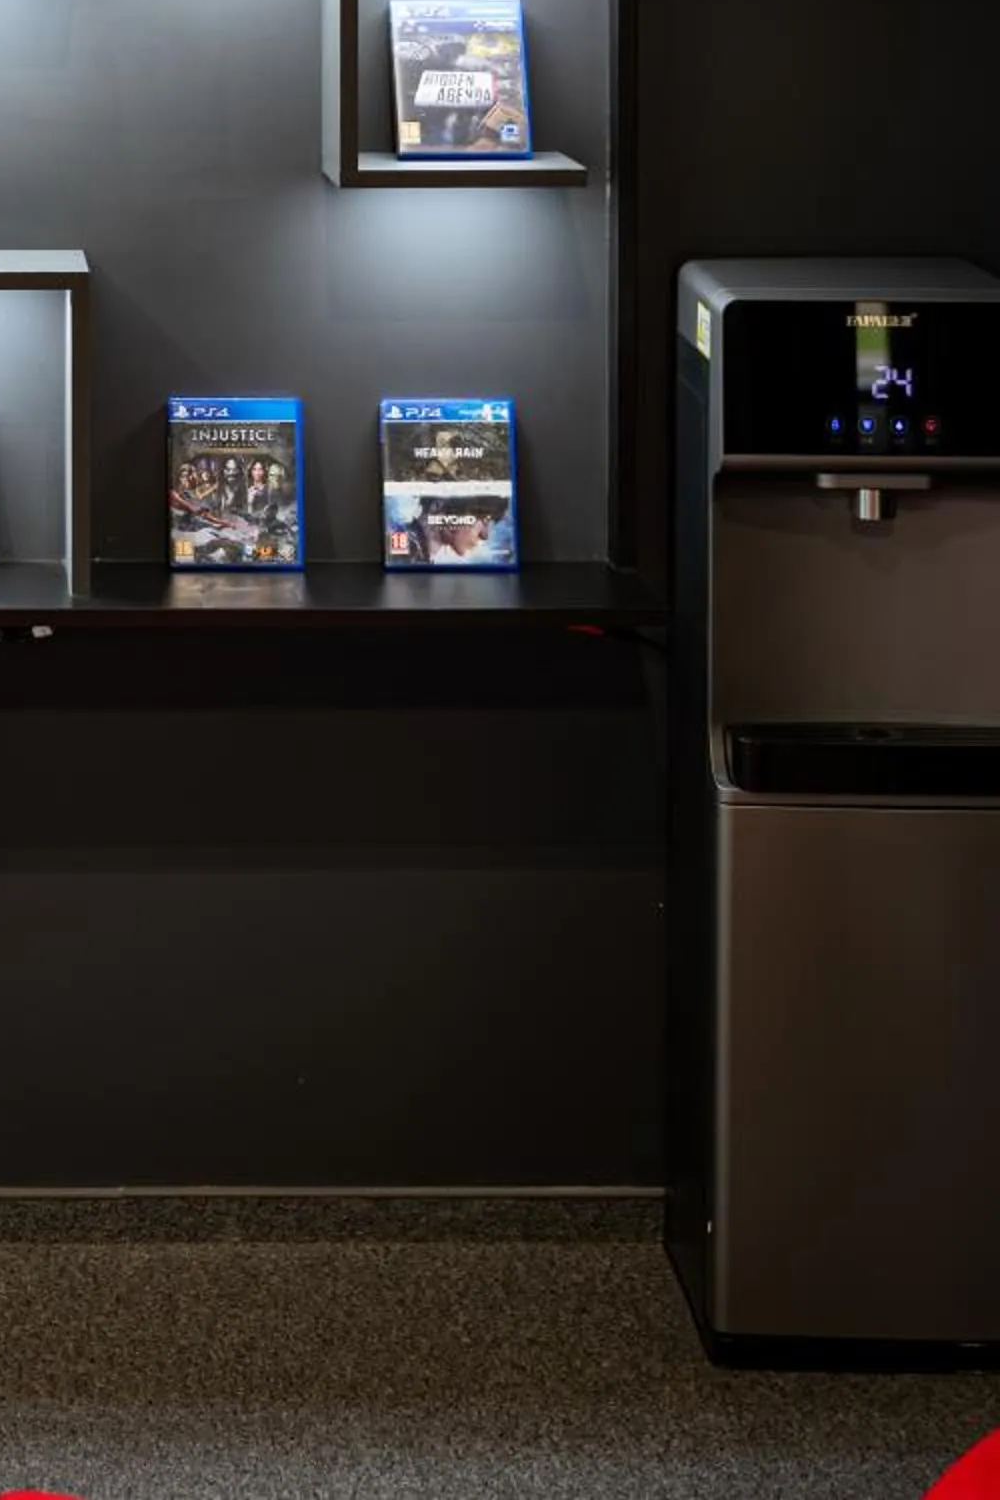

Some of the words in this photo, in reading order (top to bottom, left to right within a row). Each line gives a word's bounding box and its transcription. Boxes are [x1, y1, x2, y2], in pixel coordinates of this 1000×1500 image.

[436, 88, 491, 103] AGENDA
[871, 364, 913, 399] 24
[193, 407, 230, 418] PS4
[405, 407, 442, 418] PS4
[191, 428, 277, 442] INJUSTICE
[455, 447, 484, 459] RAIN
[427, 514, 477, 526] BEYOND
[391, 532, 408, 549] 18
